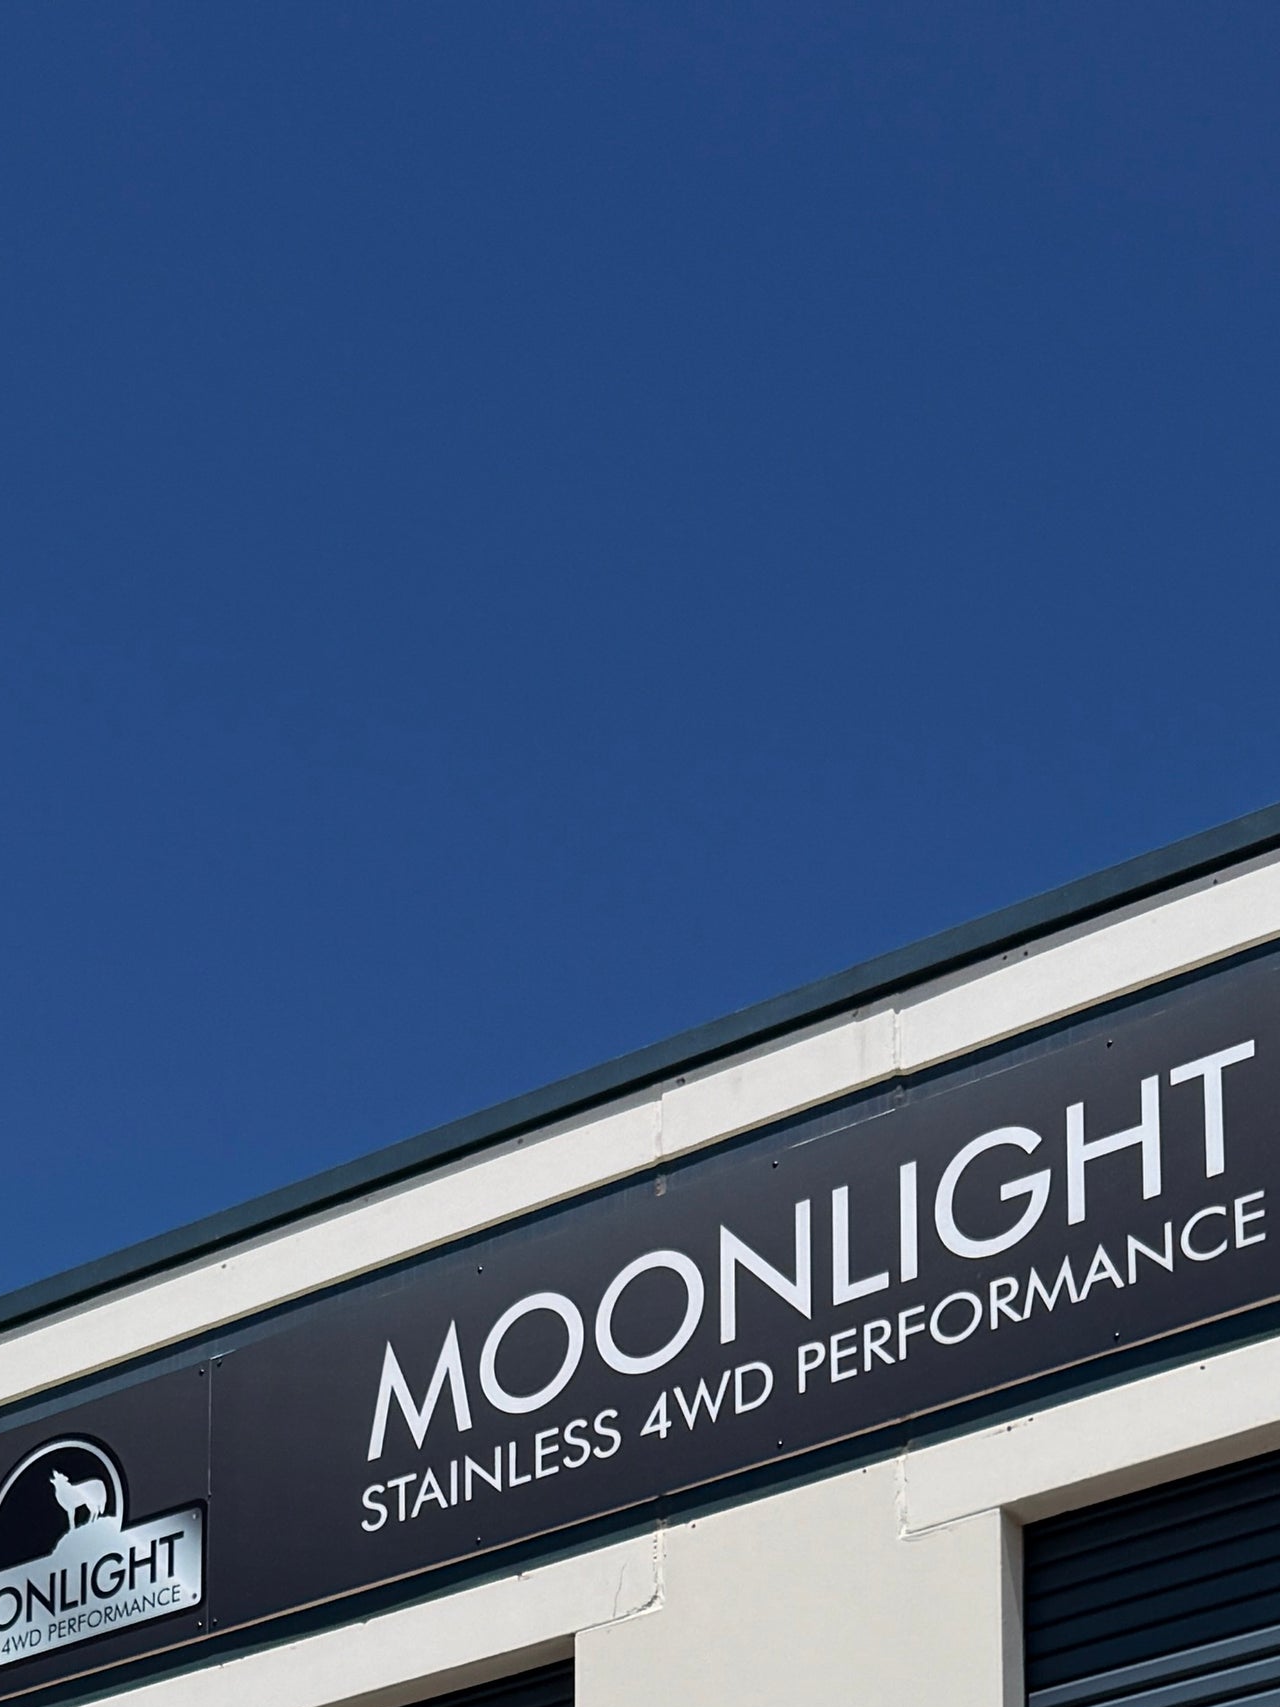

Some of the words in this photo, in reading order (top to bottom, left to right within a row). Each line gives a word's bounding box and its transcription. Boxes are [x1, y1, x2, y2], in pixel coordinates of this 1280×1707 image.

[361, 1408, 622, 1533] STAINLESS
[640, 1361, 773, 1439] 4WD
[797, 1189, 1267, 1394] PERFORMANCE
[367, 1039, 1256, 1462] MOONLIGHT
[1, 1628, 41, 1655] 4WD
[48, 1584, 182, 1642] PERFORMANCE
